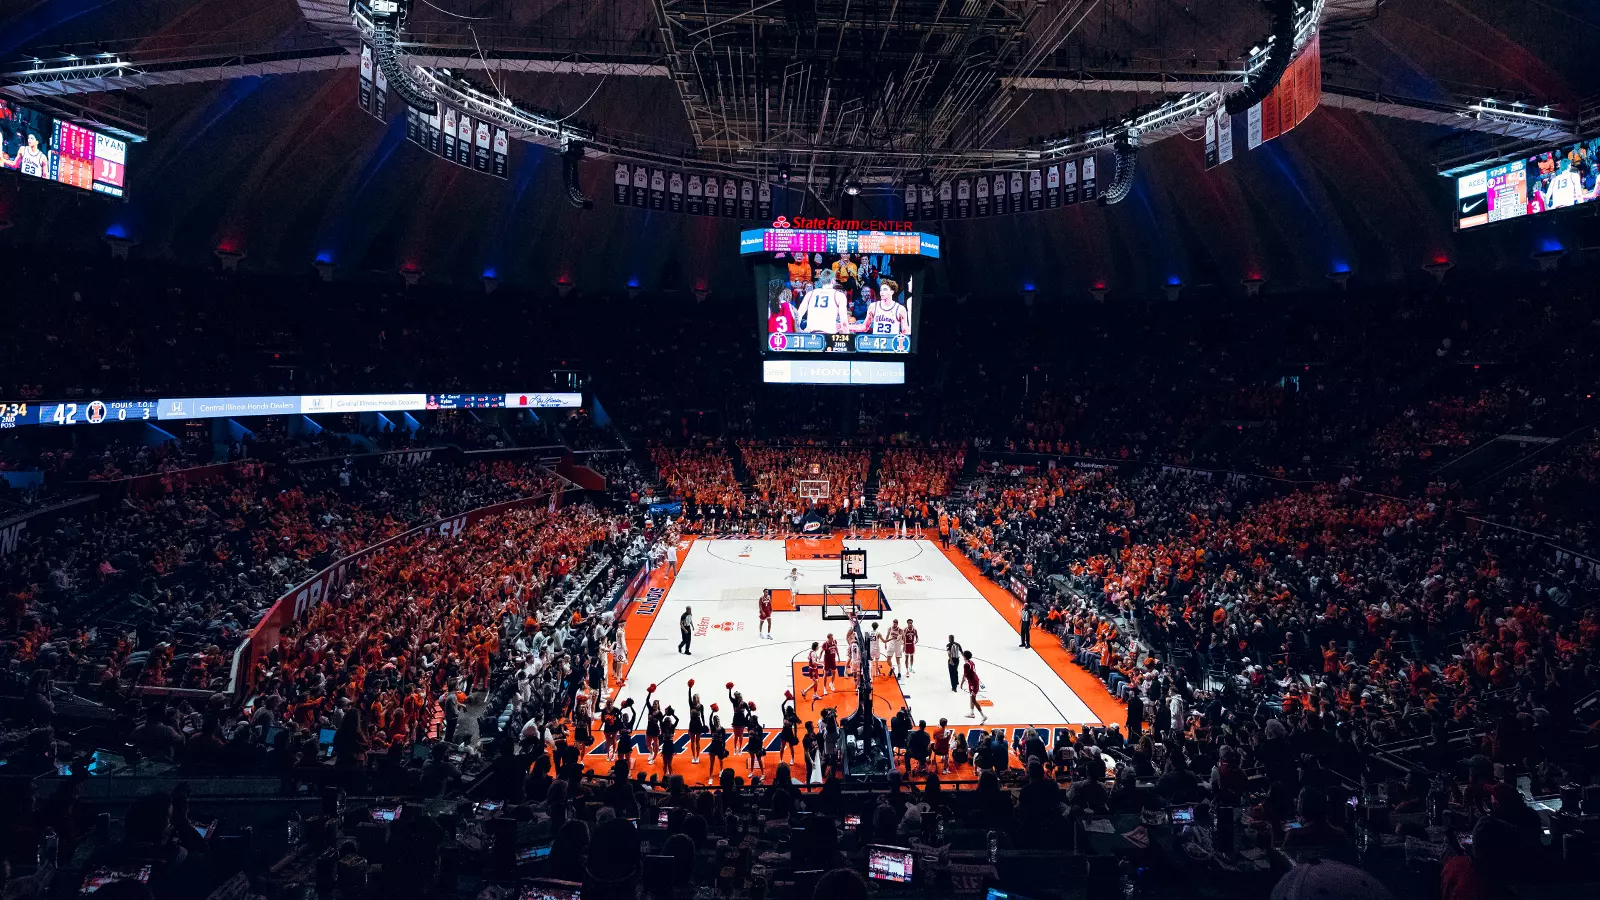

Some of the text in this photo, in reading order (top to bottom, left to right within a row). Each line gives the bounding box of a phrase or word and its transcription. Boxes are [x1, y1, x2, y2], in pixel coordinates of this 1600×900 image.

[97, 135, 124, 152] RYAN
[24, 164, 37, 175] 23
[1468, 177, 1486, 188] ACES
[1557, 178, 1567, 190] 13
[1532, 200, 1541, 213] 3
[861, 220, 914, 231] CENTER
[814, 295, 829, 309] 13
[775, 315, 788, 333] 3
[877, 322, 893, 333] 23
[793, 336, 805, 348] 31
[831, 334, 850, 342] 17:34
[873, 337, 887, 349] 42
[811, 367, 862, 377] HONDA
[1, 415, 16, 423] 2ND
[53, 403, 78, 425] 42
[200, 403, 225, 412] Central
[118, 407, 151, 421] 0 3
